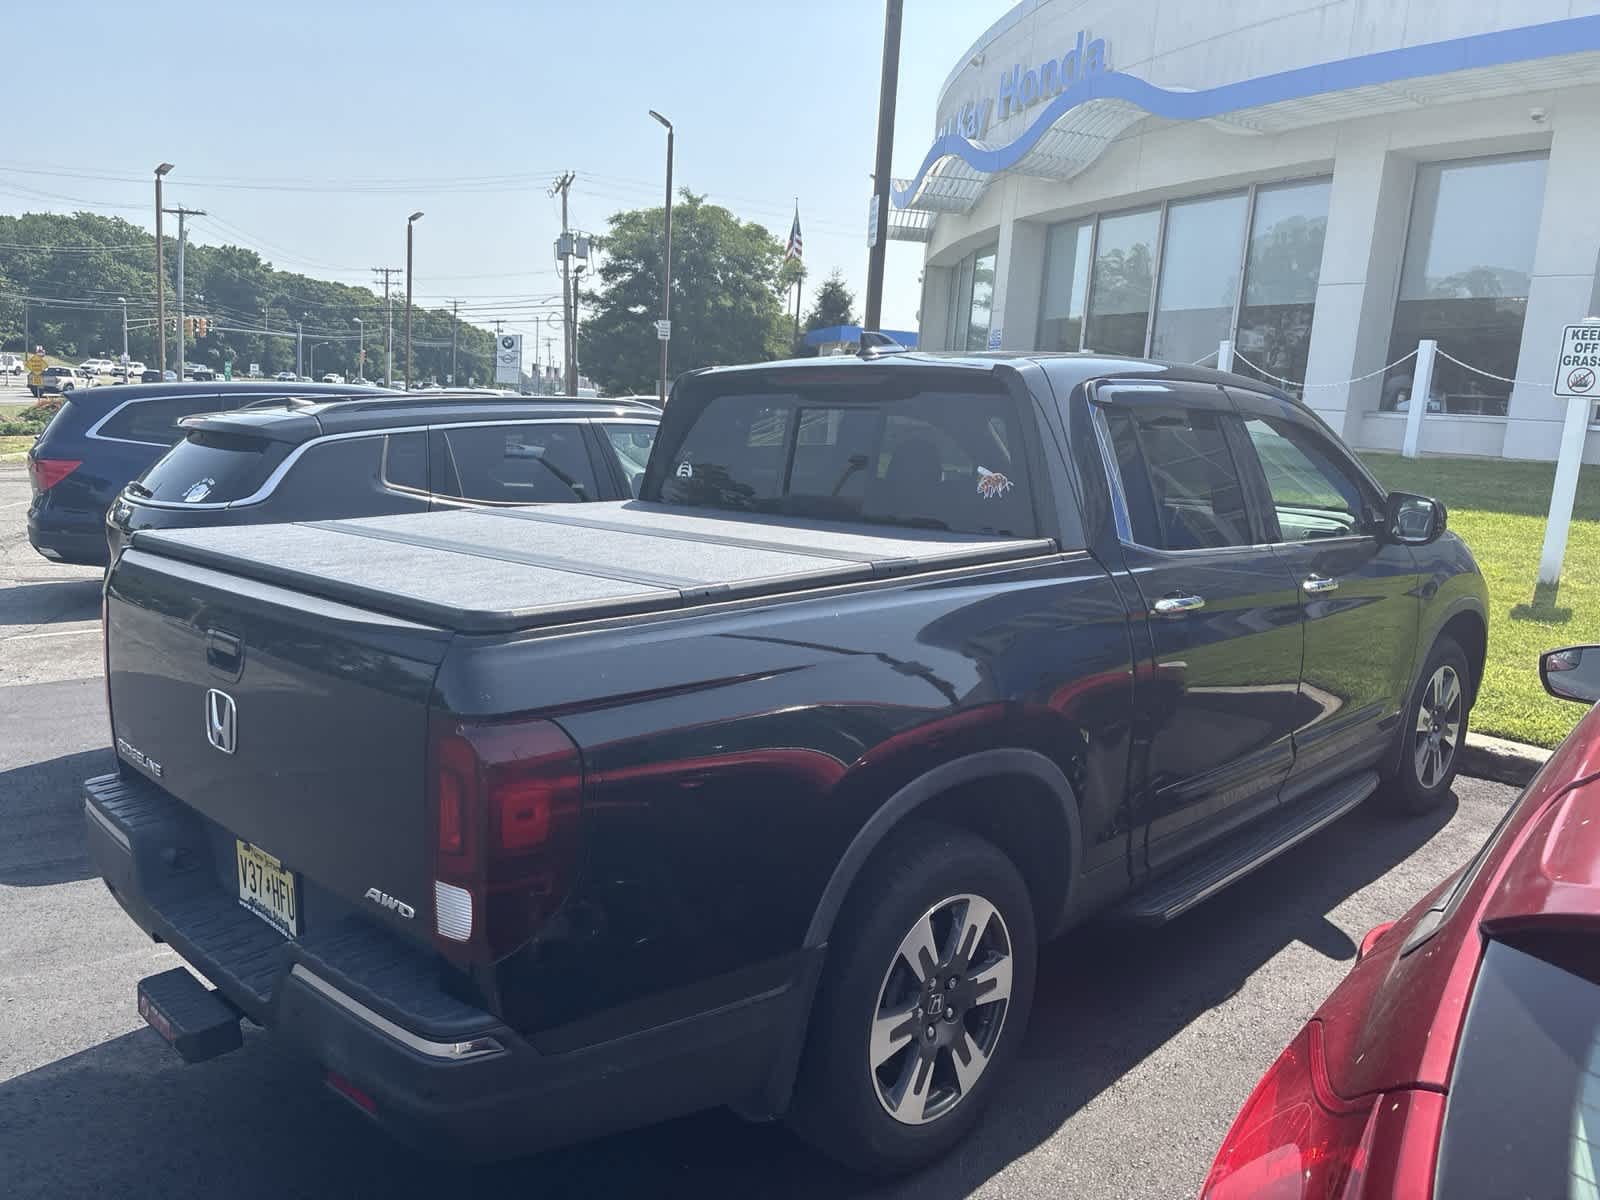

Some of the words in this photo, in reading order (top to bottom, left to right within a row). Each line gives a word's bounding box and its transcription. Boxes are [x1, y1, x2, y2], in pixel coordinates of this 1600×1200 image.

[998, 31, 1106, 117] Honda
[1571, 329, 1600, 340] KEE
[1574, 342, 1599, 353] OFF
[1563, 355, 1600, 367] GRAS
[364, 887, 416, 919] AWD
